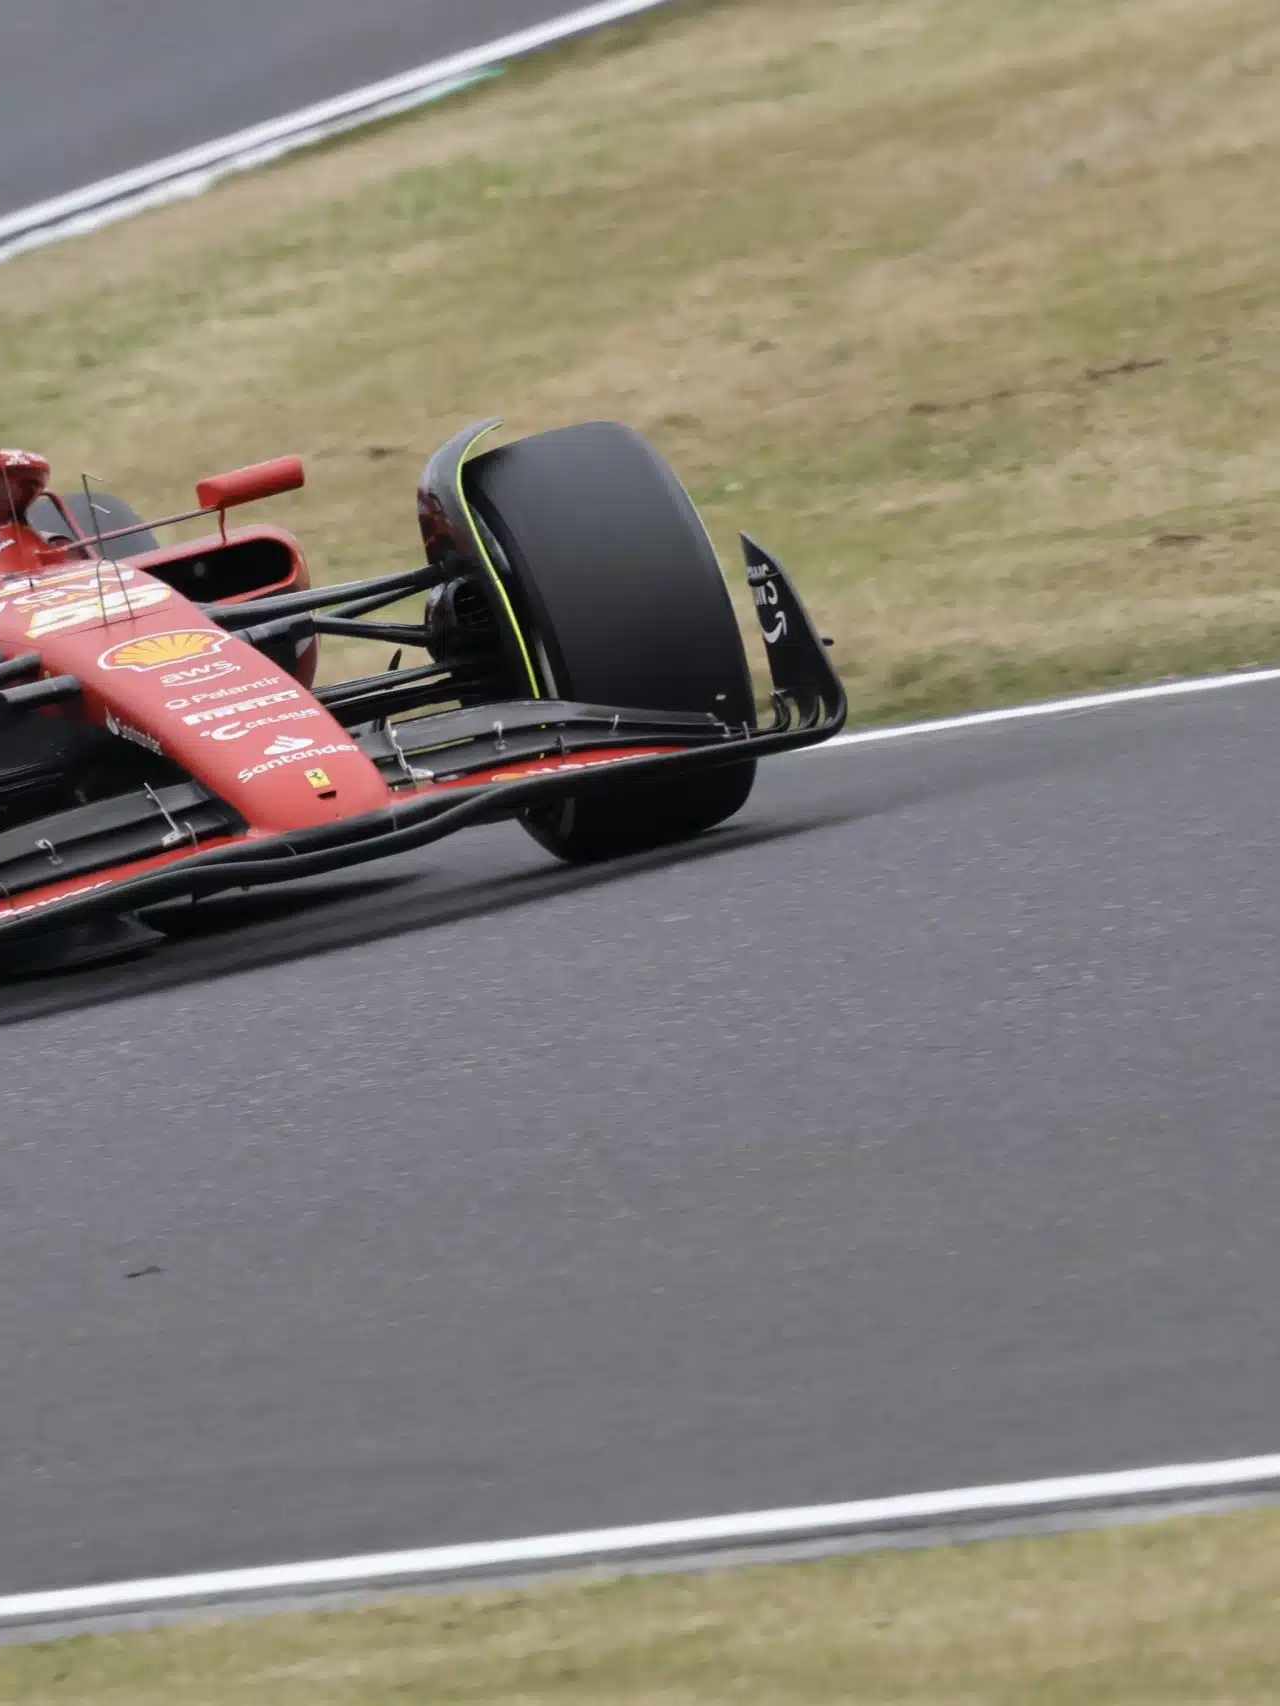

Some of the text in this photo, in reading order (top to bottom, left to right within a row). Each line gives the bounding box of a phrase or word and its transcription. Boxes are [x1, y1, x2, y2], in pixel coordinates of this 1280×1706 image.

[160, 660, 234, 684] aws
[191, 675, 281, 704] Palantir
[237, 743, 360, 783] Santander
